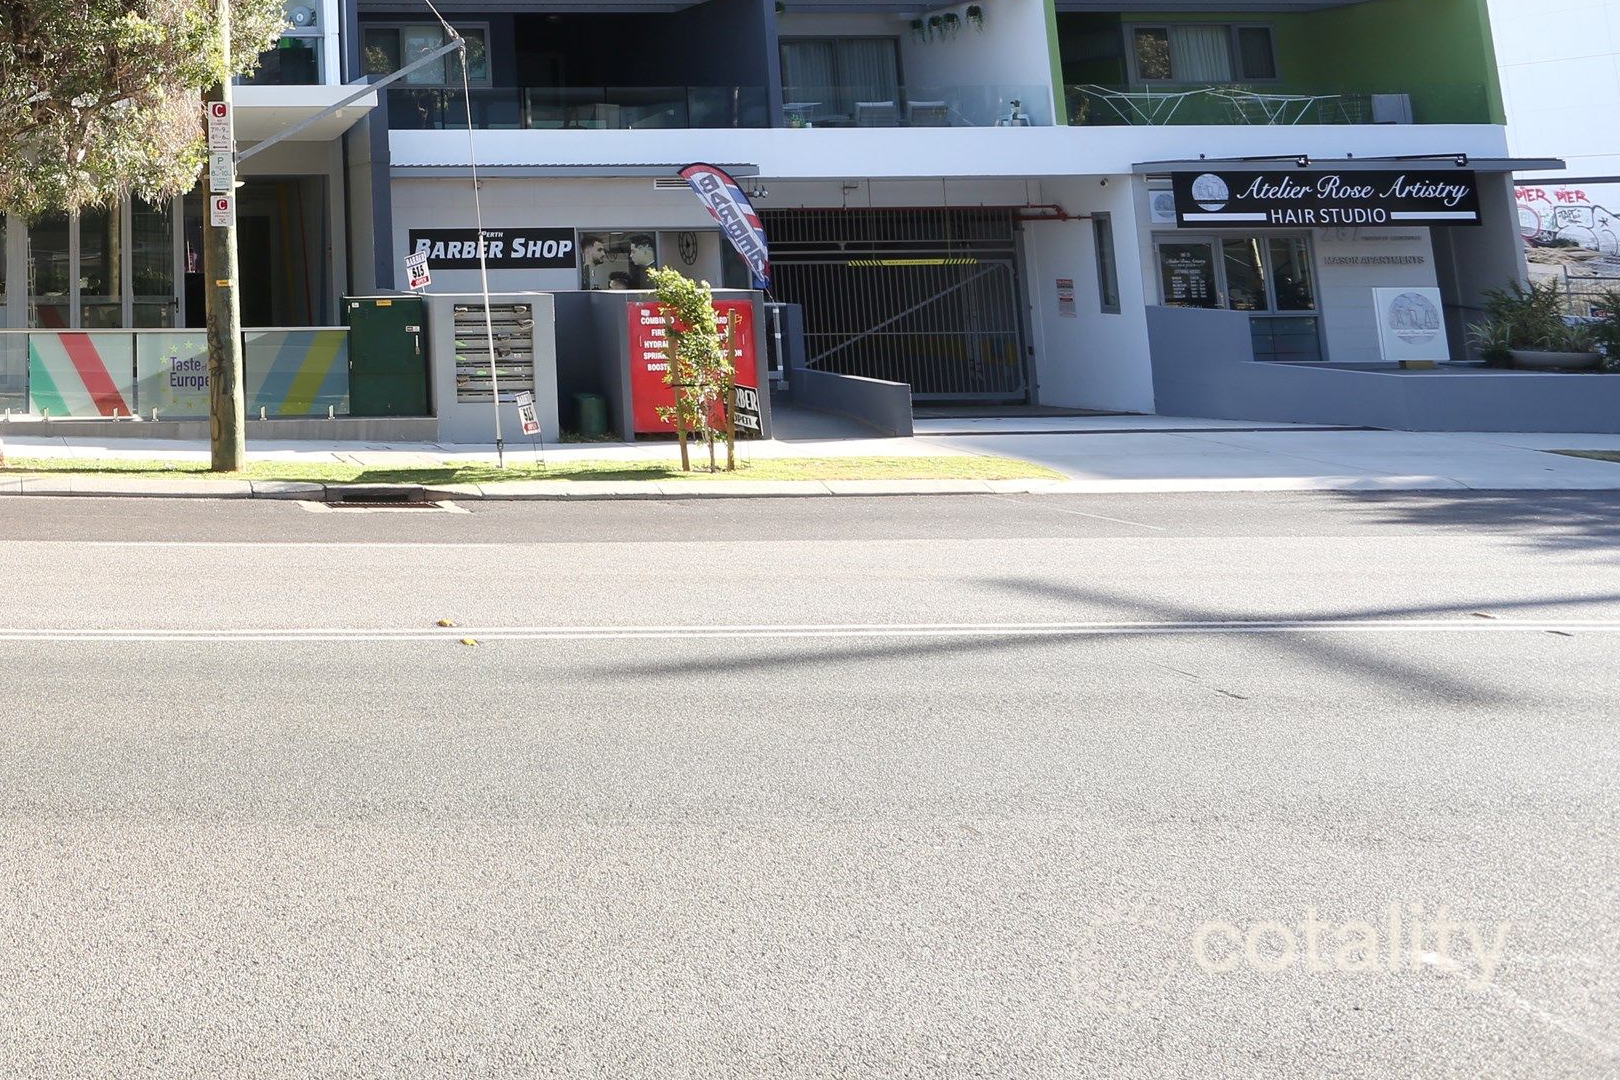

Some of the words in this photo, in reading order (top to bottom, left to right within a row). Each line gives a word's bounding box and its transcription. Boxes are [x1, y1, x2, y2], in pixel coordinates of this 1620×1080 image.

[217, 156, 224, 165] P
[1236, 175, 1313, 199] Atelier
[1317, 175, 1375, 199] Rose
[1379, 175, 1470, 207] Artistry
[1270, 209, 1316, 224] HAIR
[1320, 208, 1386, 223] STUDIO
[415, 238, 503, 259] BARBER
[510, 238, 573, 258] SHOP
[1324, 256, 1358, 265] MASON
[1360, 256, 1424, 265] APARTMENTS
[412, 265, 425, 278] $15
[170, 356, 201, 372] Taste
[647, 363, 668, 371] BOOST
